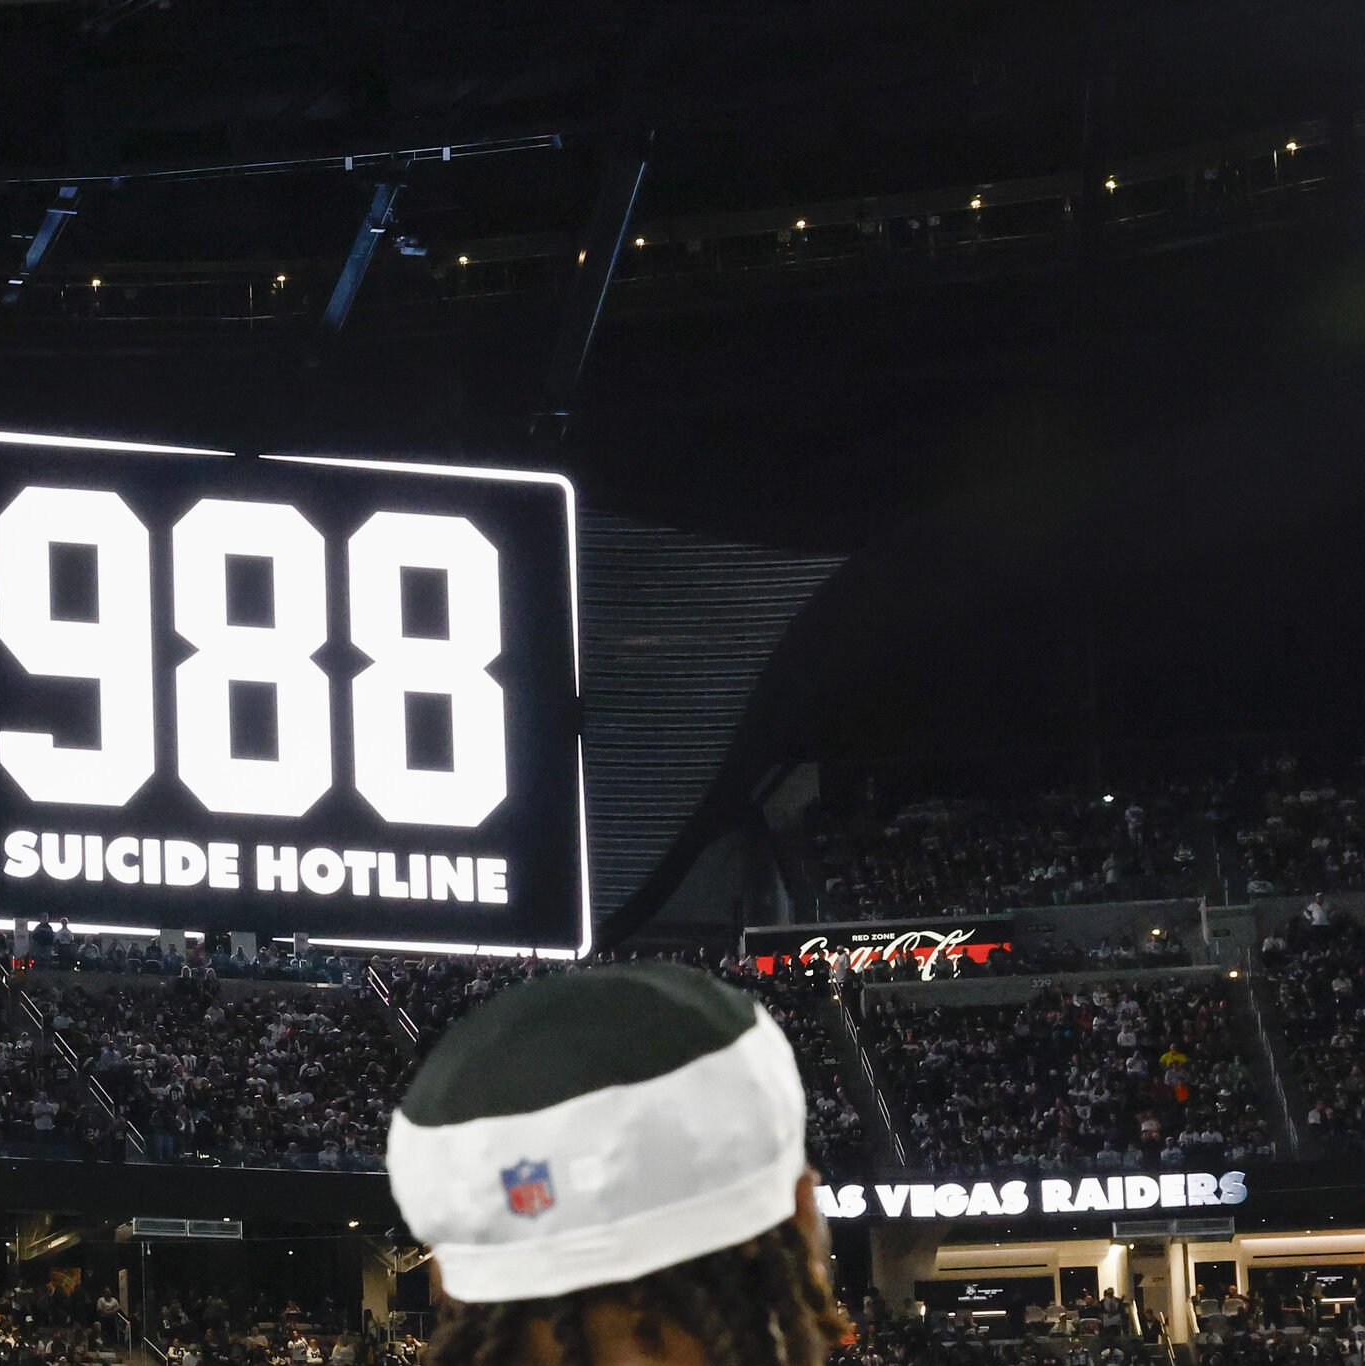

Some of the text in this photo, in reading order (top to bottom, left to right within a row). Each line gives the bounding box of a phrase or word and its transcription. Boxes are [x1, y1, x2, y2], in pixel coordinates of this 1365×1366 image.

[3, 829, 509, 905] SUICIDE HOTLINE
[852, 932, 895, 942] RED ZONE
[874, 1180, 1030, 1218] VEGAS
[1040, 1170, 1248, 1213] RAIDERS
